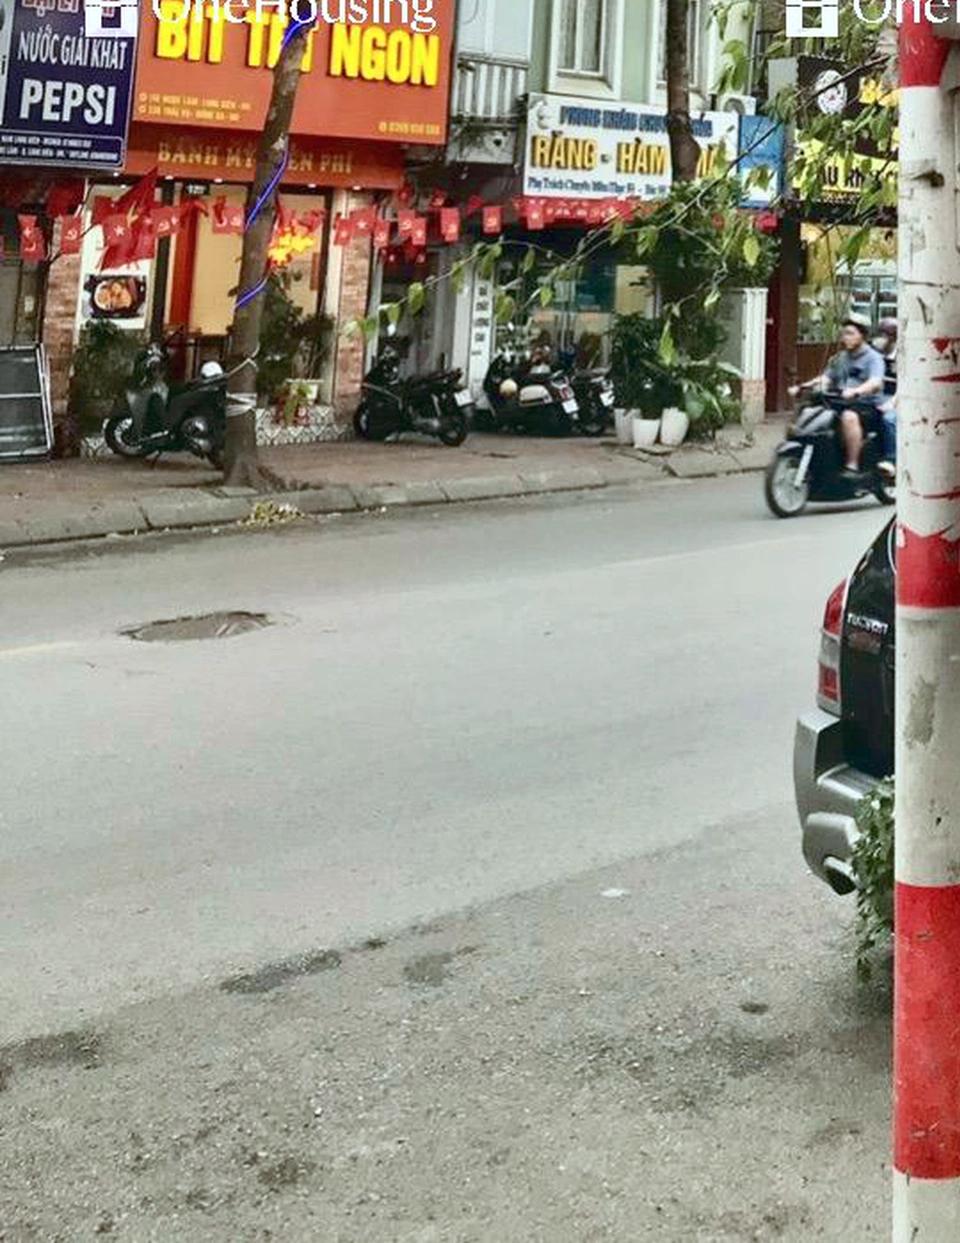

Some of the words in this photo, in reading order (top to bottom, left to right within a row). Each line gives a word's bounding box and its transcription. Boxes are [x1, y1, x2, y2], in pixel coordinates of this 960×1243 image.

[329, 22, 440, 87] NGON
[20, 78, 116, 125] PEPSI
[530, 131, 598, 171] RĂNG
[616, 137, 666, 175] HÀM
